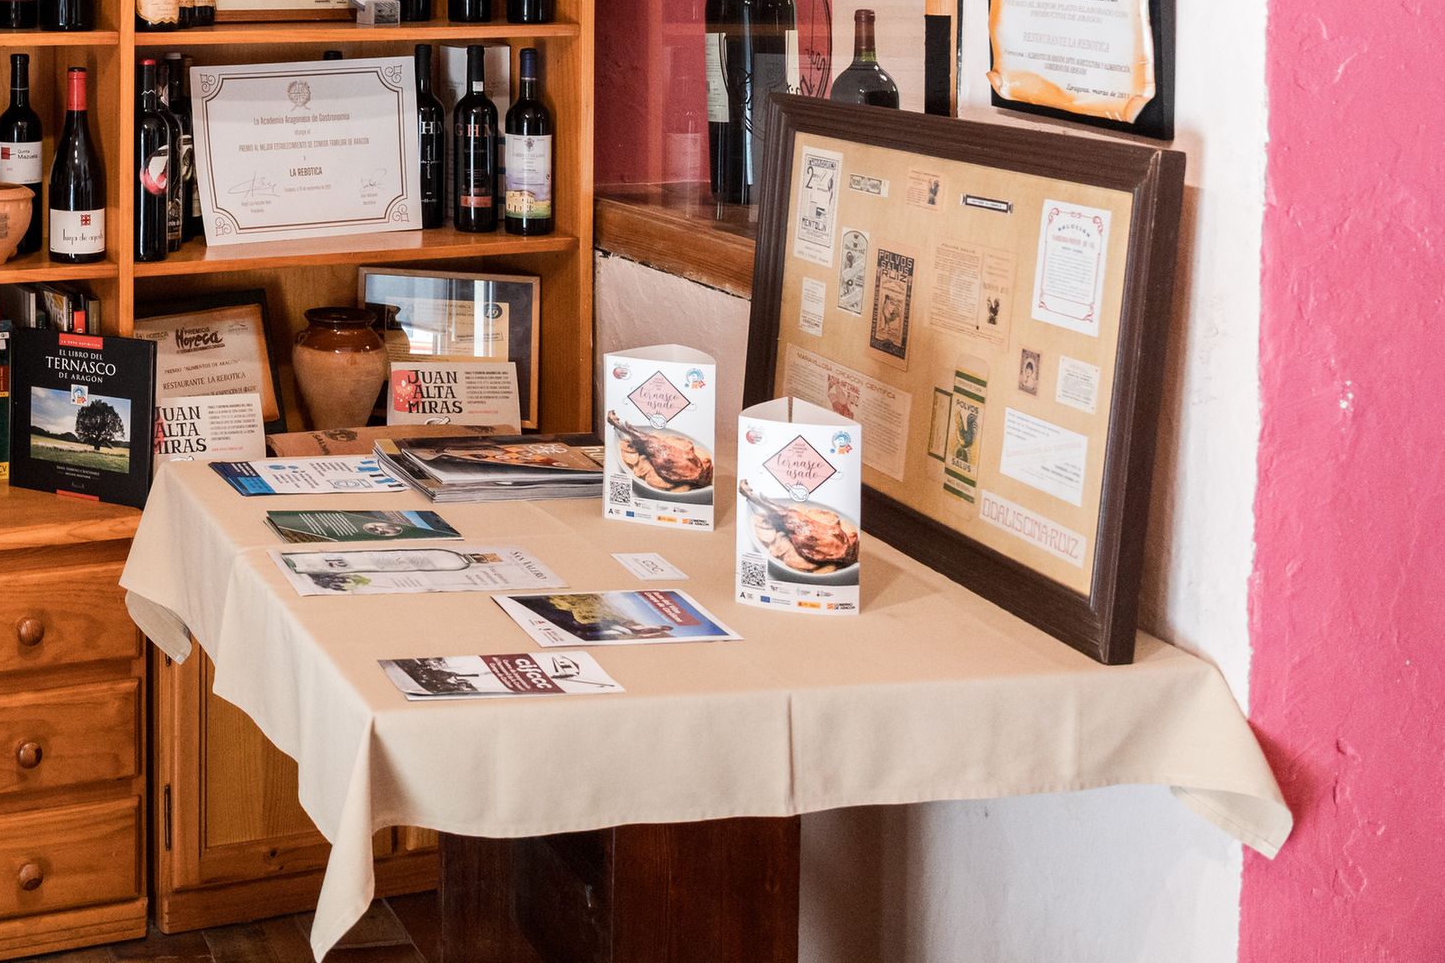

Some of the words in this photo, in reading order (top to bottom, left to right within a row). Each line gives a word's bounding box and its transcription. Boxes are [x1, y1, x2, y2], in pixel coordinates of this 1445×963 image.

[260, 116, 284, 125] Academia
[285, 115, 311, 125] Aragonesa
[311, 114, 318, 122] de
[289, 168, 297, 177] LA
[297, 167, 323, 177] REBOTICA
[878, 250, 913, 269] POLVOS
[880, 261, 909, 276] SALUS
[881, 269, 907, 283] RUIZ
[59, 349, 67, 357] EL
[68, 350, 89, 360] LIBRO
[90, 352, 103, 361] DEL
[797, 352, 833, 372] MARAVILLOSA
[45, 355, 117, 376] TERNASCO
[58, 372, 69, 380] DE
[71, 373, 104, 383] ARAGÓN
[162, 377, 205, 390] RESTAURANTE
[207, 375, 216, 384] LA
[216, 372, 247, 383] REBOTICA
[407, 369, 459, 385] JUAN
[412, 385, 457, 400] ALTA
[155, 405, 201, 421] JUAN
[407, 400, 464, 414] MIRAS
[955, 398, 979, 414] POLVOS
[155, 422, 201, 437] ALTA
[776, 453, 824, 471] ternasco
[951, 457, 971, 473] SALUS
[785, 468, 819, 479] asado
